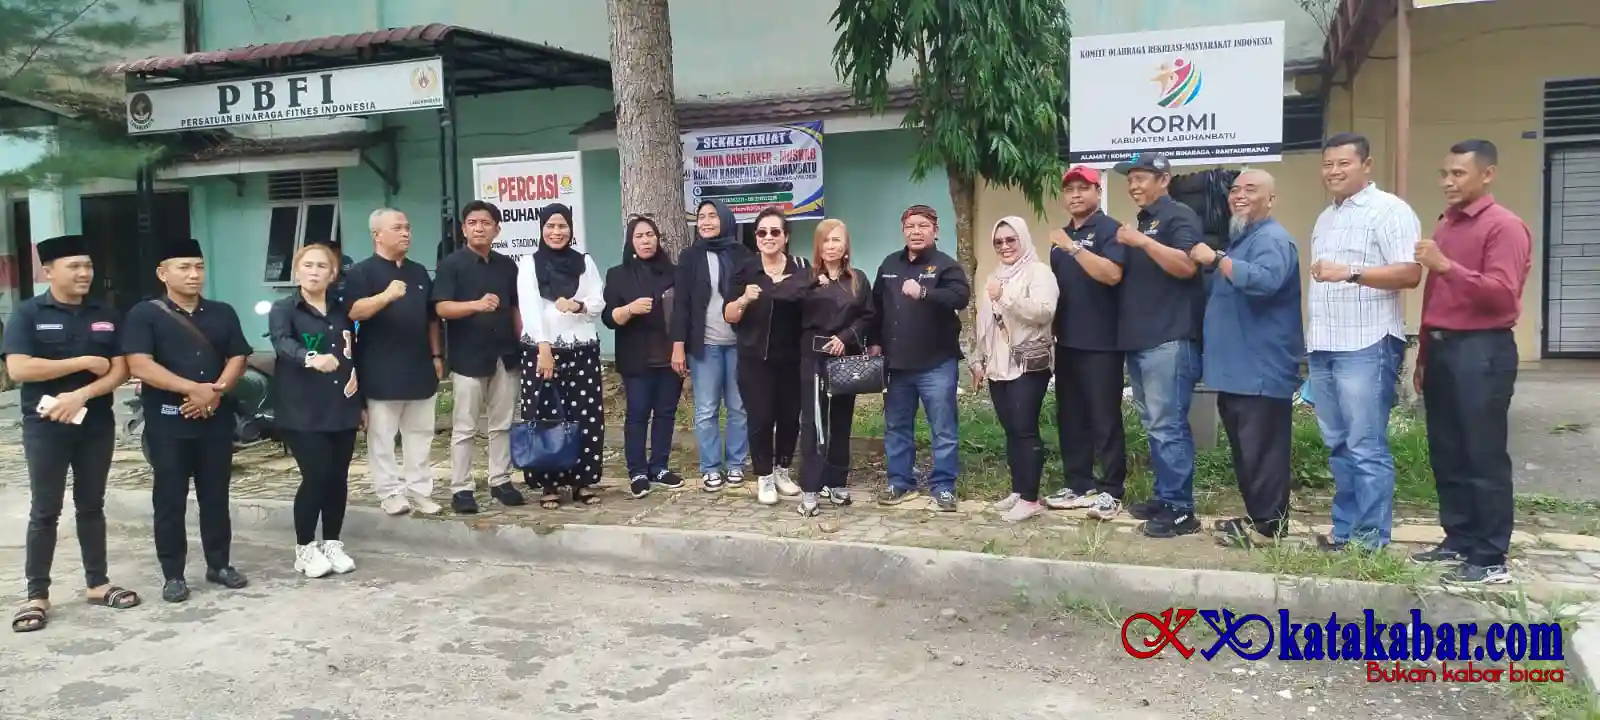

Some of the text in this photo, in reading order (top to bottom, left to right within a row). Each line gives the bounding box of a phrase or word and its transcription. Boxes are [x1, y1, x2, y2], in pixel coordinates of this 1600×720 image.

[1080, 48, 1106, 59] KOMITE
[1108, 46, 1146, 57] OLAHRAGA
[1233, 36, 1273, 48] INDONESIA
[181, 101, 376, 127] PERSATUAN BINARAGA FITNES INDONESIA
[1130, 112, 1216, 135] KORMI
[703, 132, 786, 149] SEKRETARIAT
[1111, 132, 1236, 145] KABUPATEN LABUHANBATU
[1110, 152, 1140, 160] KOMPLE
[719, 165, 761, 179] KABUPATEN
[763, 162, 817, 177] LABUHANBATU
[497, 174, 559, 202] PERCASI
[511, 238, 539, 248] STADION
